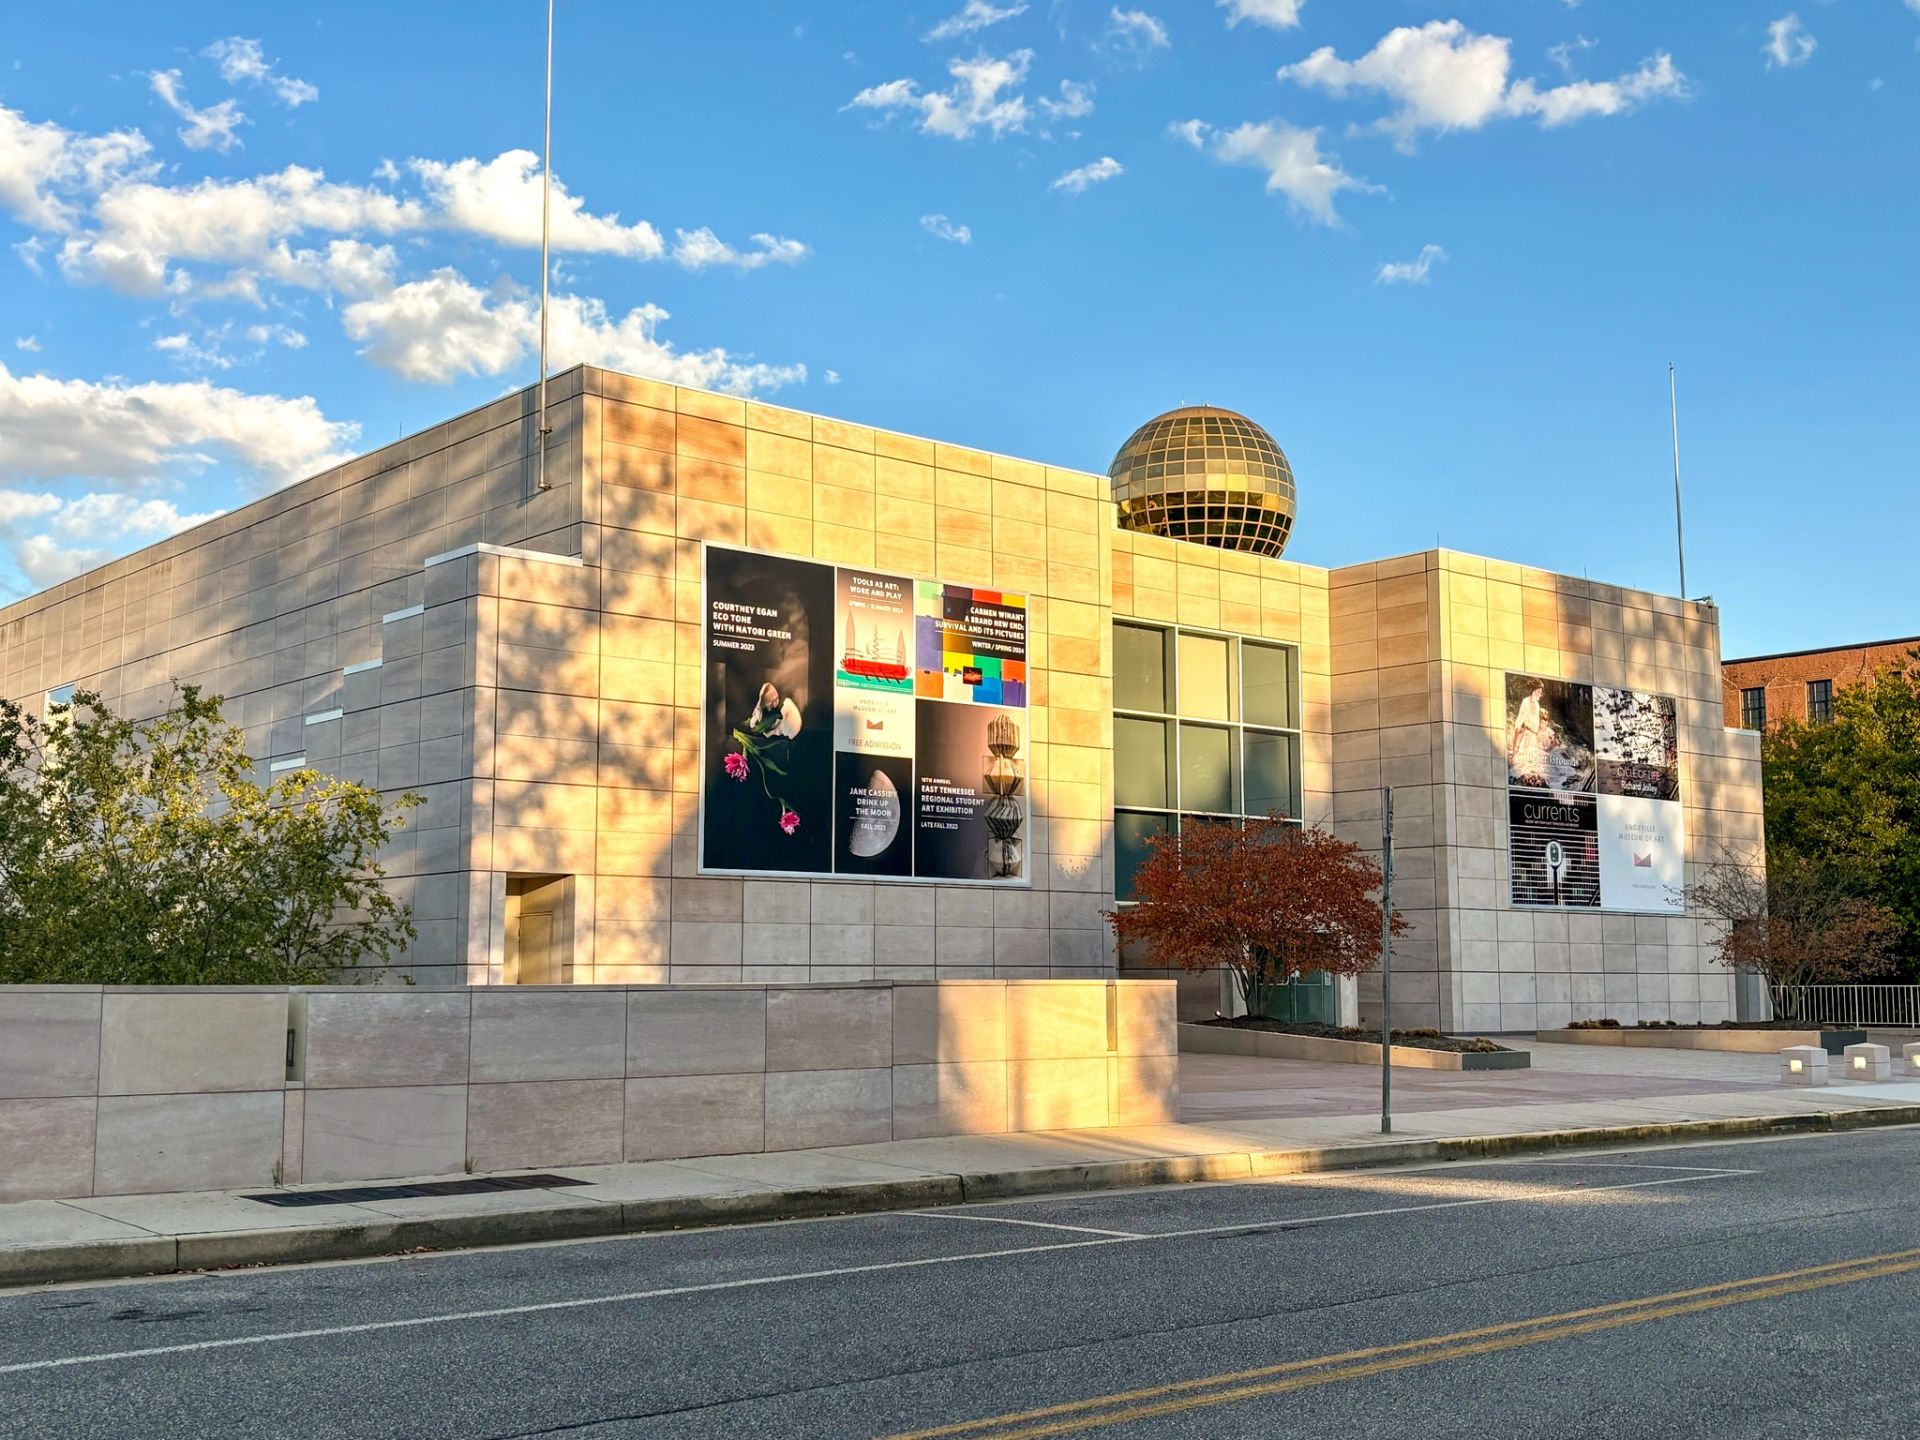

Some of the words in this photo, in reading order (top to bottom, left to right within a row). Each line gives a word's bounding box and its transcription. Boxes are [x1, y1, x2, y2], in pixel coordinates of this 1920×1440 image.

[853, 577, 873, 586] TOOLS
[850, 586, 869, 594] WORK
[886, 592, 902, 600] PLAY
[713, 602, 755, 614] COURTNEY
[757, 607, 778, 617] EGAN
[970, 607, 997, 617] CARMEN
[999, 612, 1024, 621] WINANT
[713, 612, 729, 620] ECO
[730, 614, 752, 624] TONE
[971, 617, 993, 626] BRAND
[994, 620, 1009, 628] NEW
[1010, 622, 1024, 631] END:
[713, 622, 734, 632] WITH
[736, 626, 765, 636] NATORI
[767, 629, 792, 640] GREEN
[935, 621, 967, 632] SURVIVAL
[984, 627, 994, 636] ITS
[995, 629, 1024, 640] PICTURES
[713, 640, 739, 649] SUMMER
[972, 641, 991, 649] WINTER
[849, 739, 863, 747] FREE
[864, 740, 900, 750] ADMISSION
[940, 786, 975, 795] TENNESSEE
[1621, 780, 1642, 791] Richard
[849, 788, 866, 796] JANE
[869, 790, 896, 798] CASSIDY
[857, 798, 878, 806] DRINK
[921, 795, 954, 804] REGIONAL
[856, 808, 869, 816] THE
[936, 806, 973, 814] EXHIBITION
[1524, 804, 1580, 822] currents
